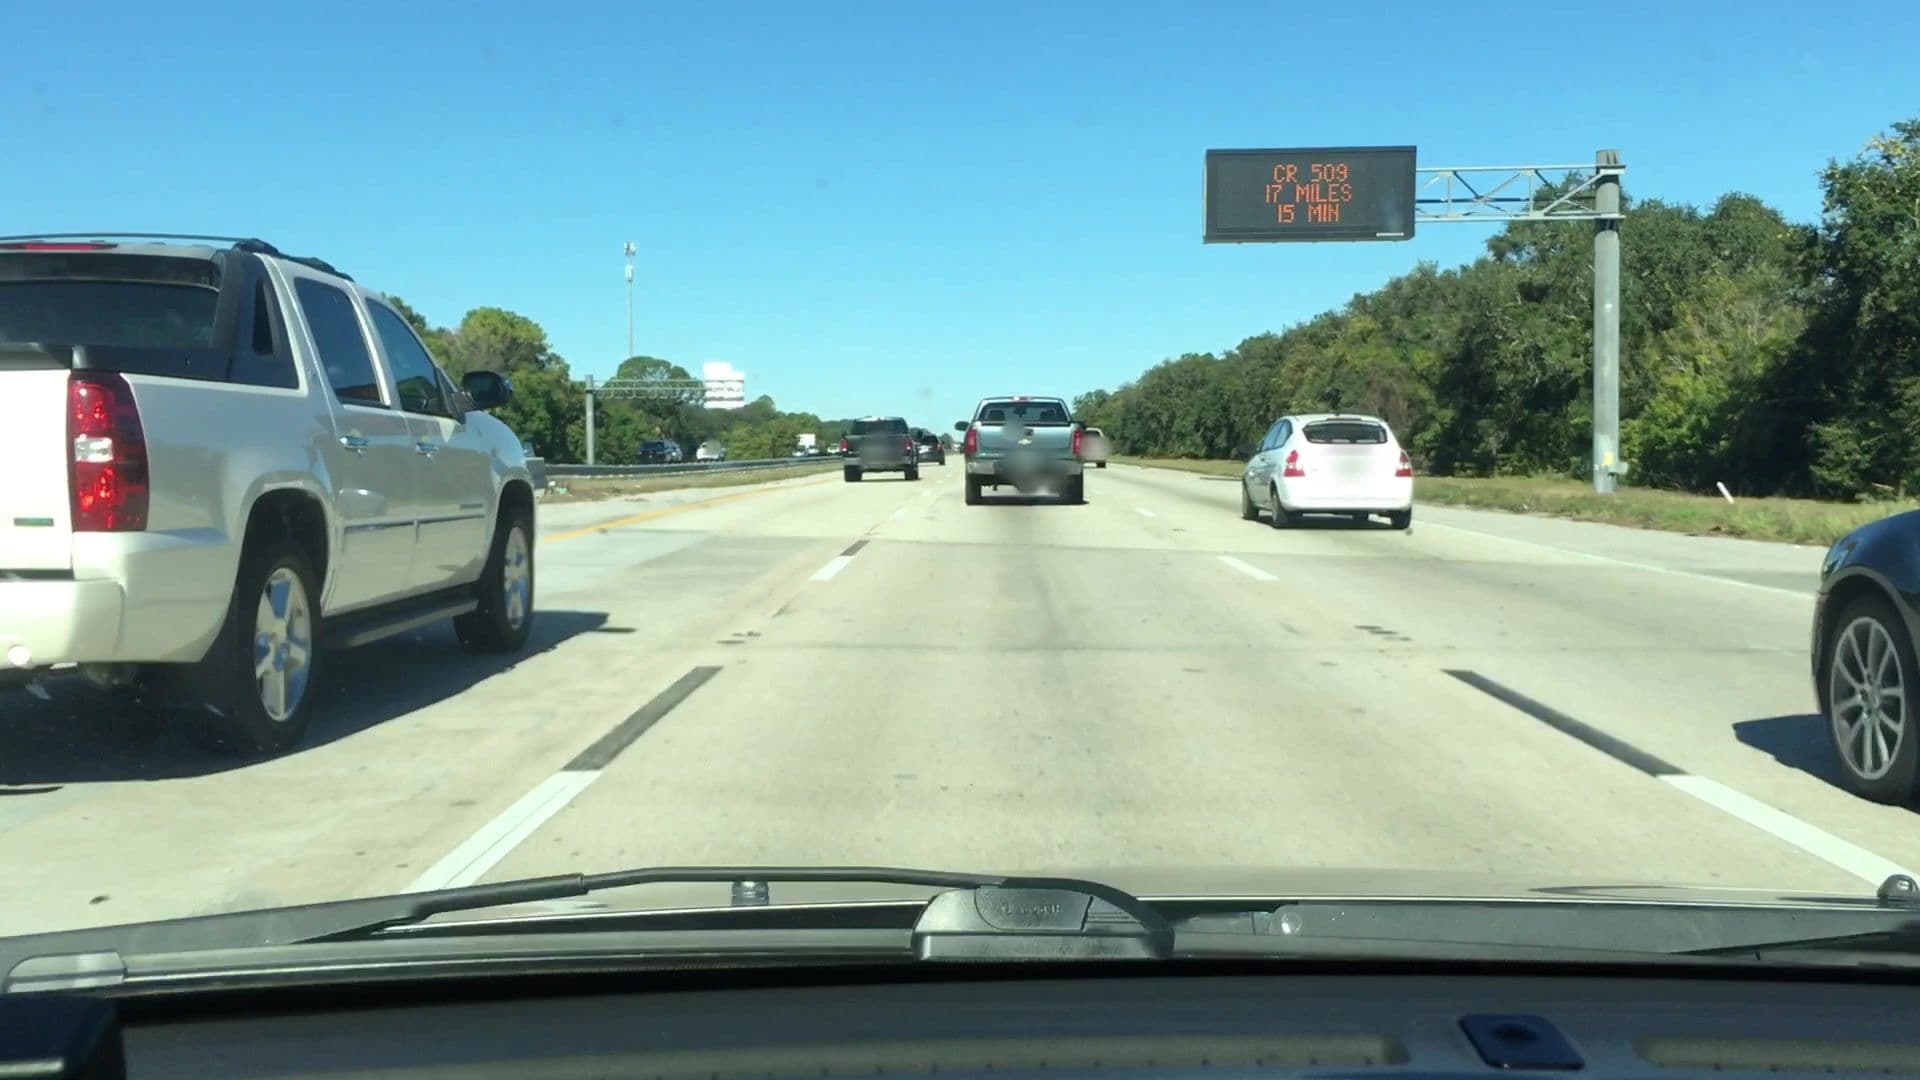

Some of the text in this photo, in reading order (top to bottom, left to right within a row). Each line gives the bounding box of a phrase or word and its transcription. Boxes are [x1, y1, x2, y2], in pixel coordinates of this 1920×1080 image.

[1273, 163, 1348, 182] CR 509
[1265, 183, 1352, 203] 17 MILES
[1278, 203, 1340, 223] 15 MIN
